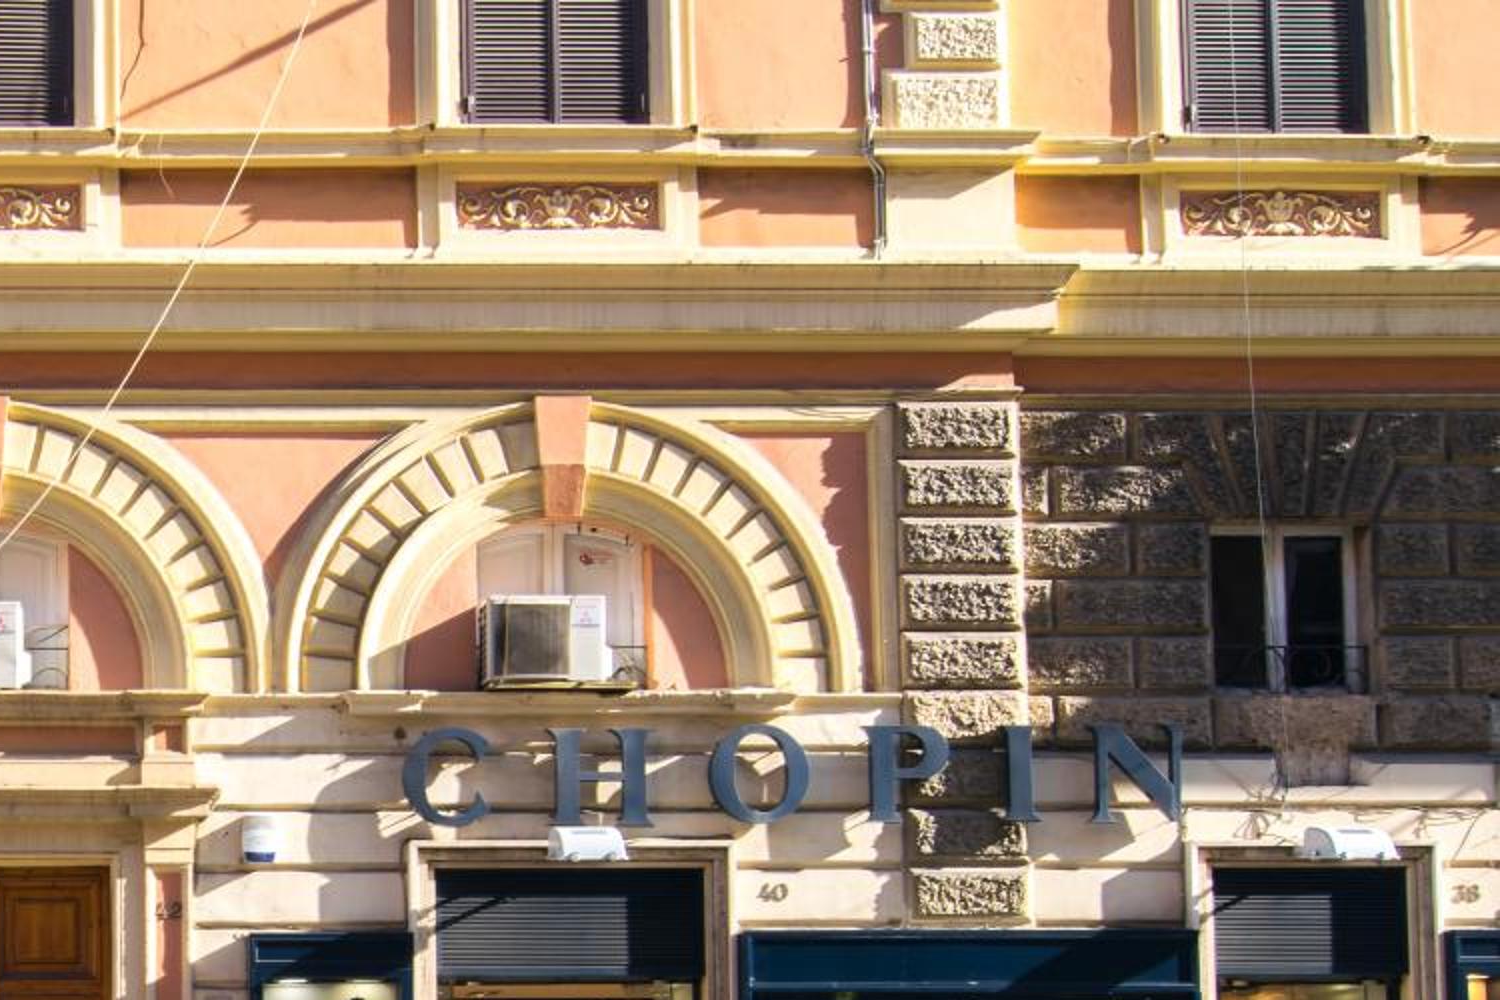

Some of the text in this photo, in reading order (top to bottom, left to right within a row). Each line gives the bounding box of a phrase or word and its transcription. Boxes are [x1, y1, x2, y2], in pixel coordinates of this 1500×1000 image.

[403, 721, 1183, 827] CHOPIN
[756, 883, 788, 902] 40
[155, 901, 182, 920] 42
